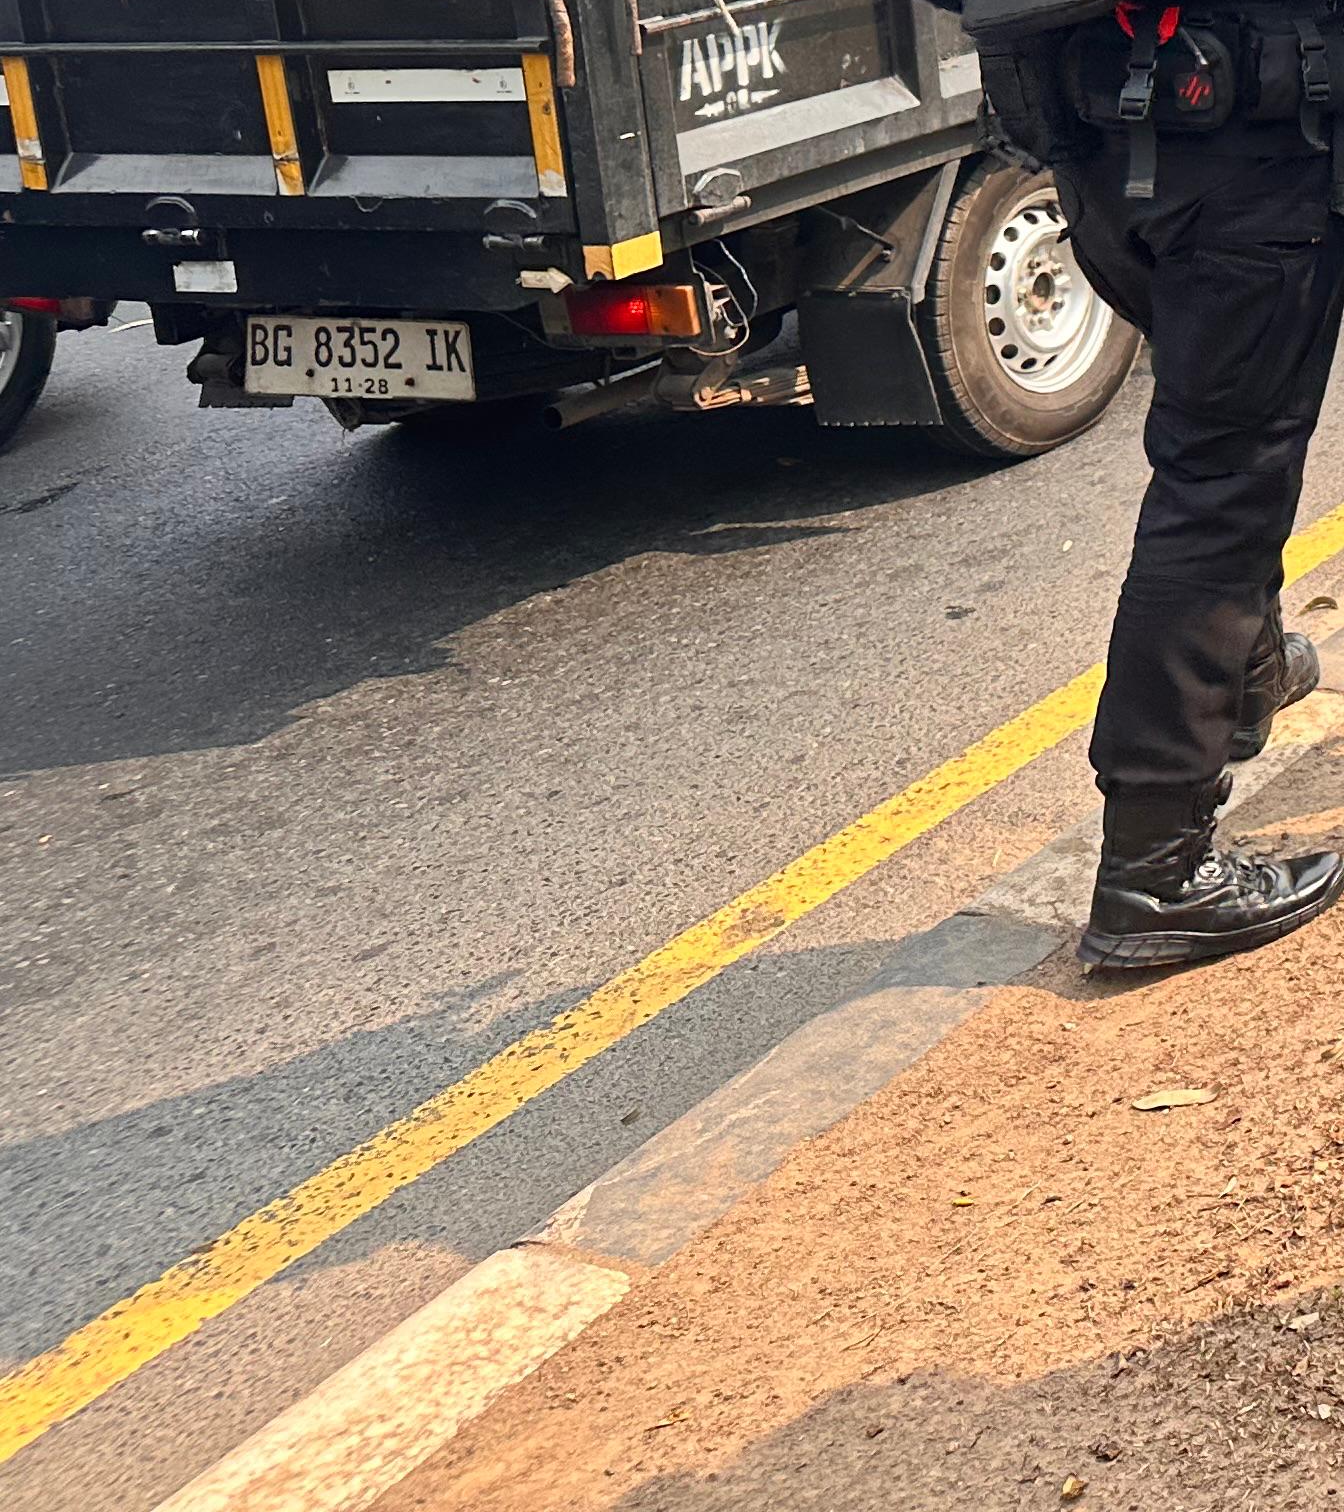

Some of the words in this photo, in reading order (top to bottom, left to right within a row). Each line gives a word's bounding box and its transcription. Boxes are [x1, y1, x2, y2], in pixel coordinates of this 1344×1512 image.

[679, 17, 789, 102] APPK
[251, 323, 293, 368] BG
[314, 326, 403, 370] 8352
[425, 328, 466, 373] IK
